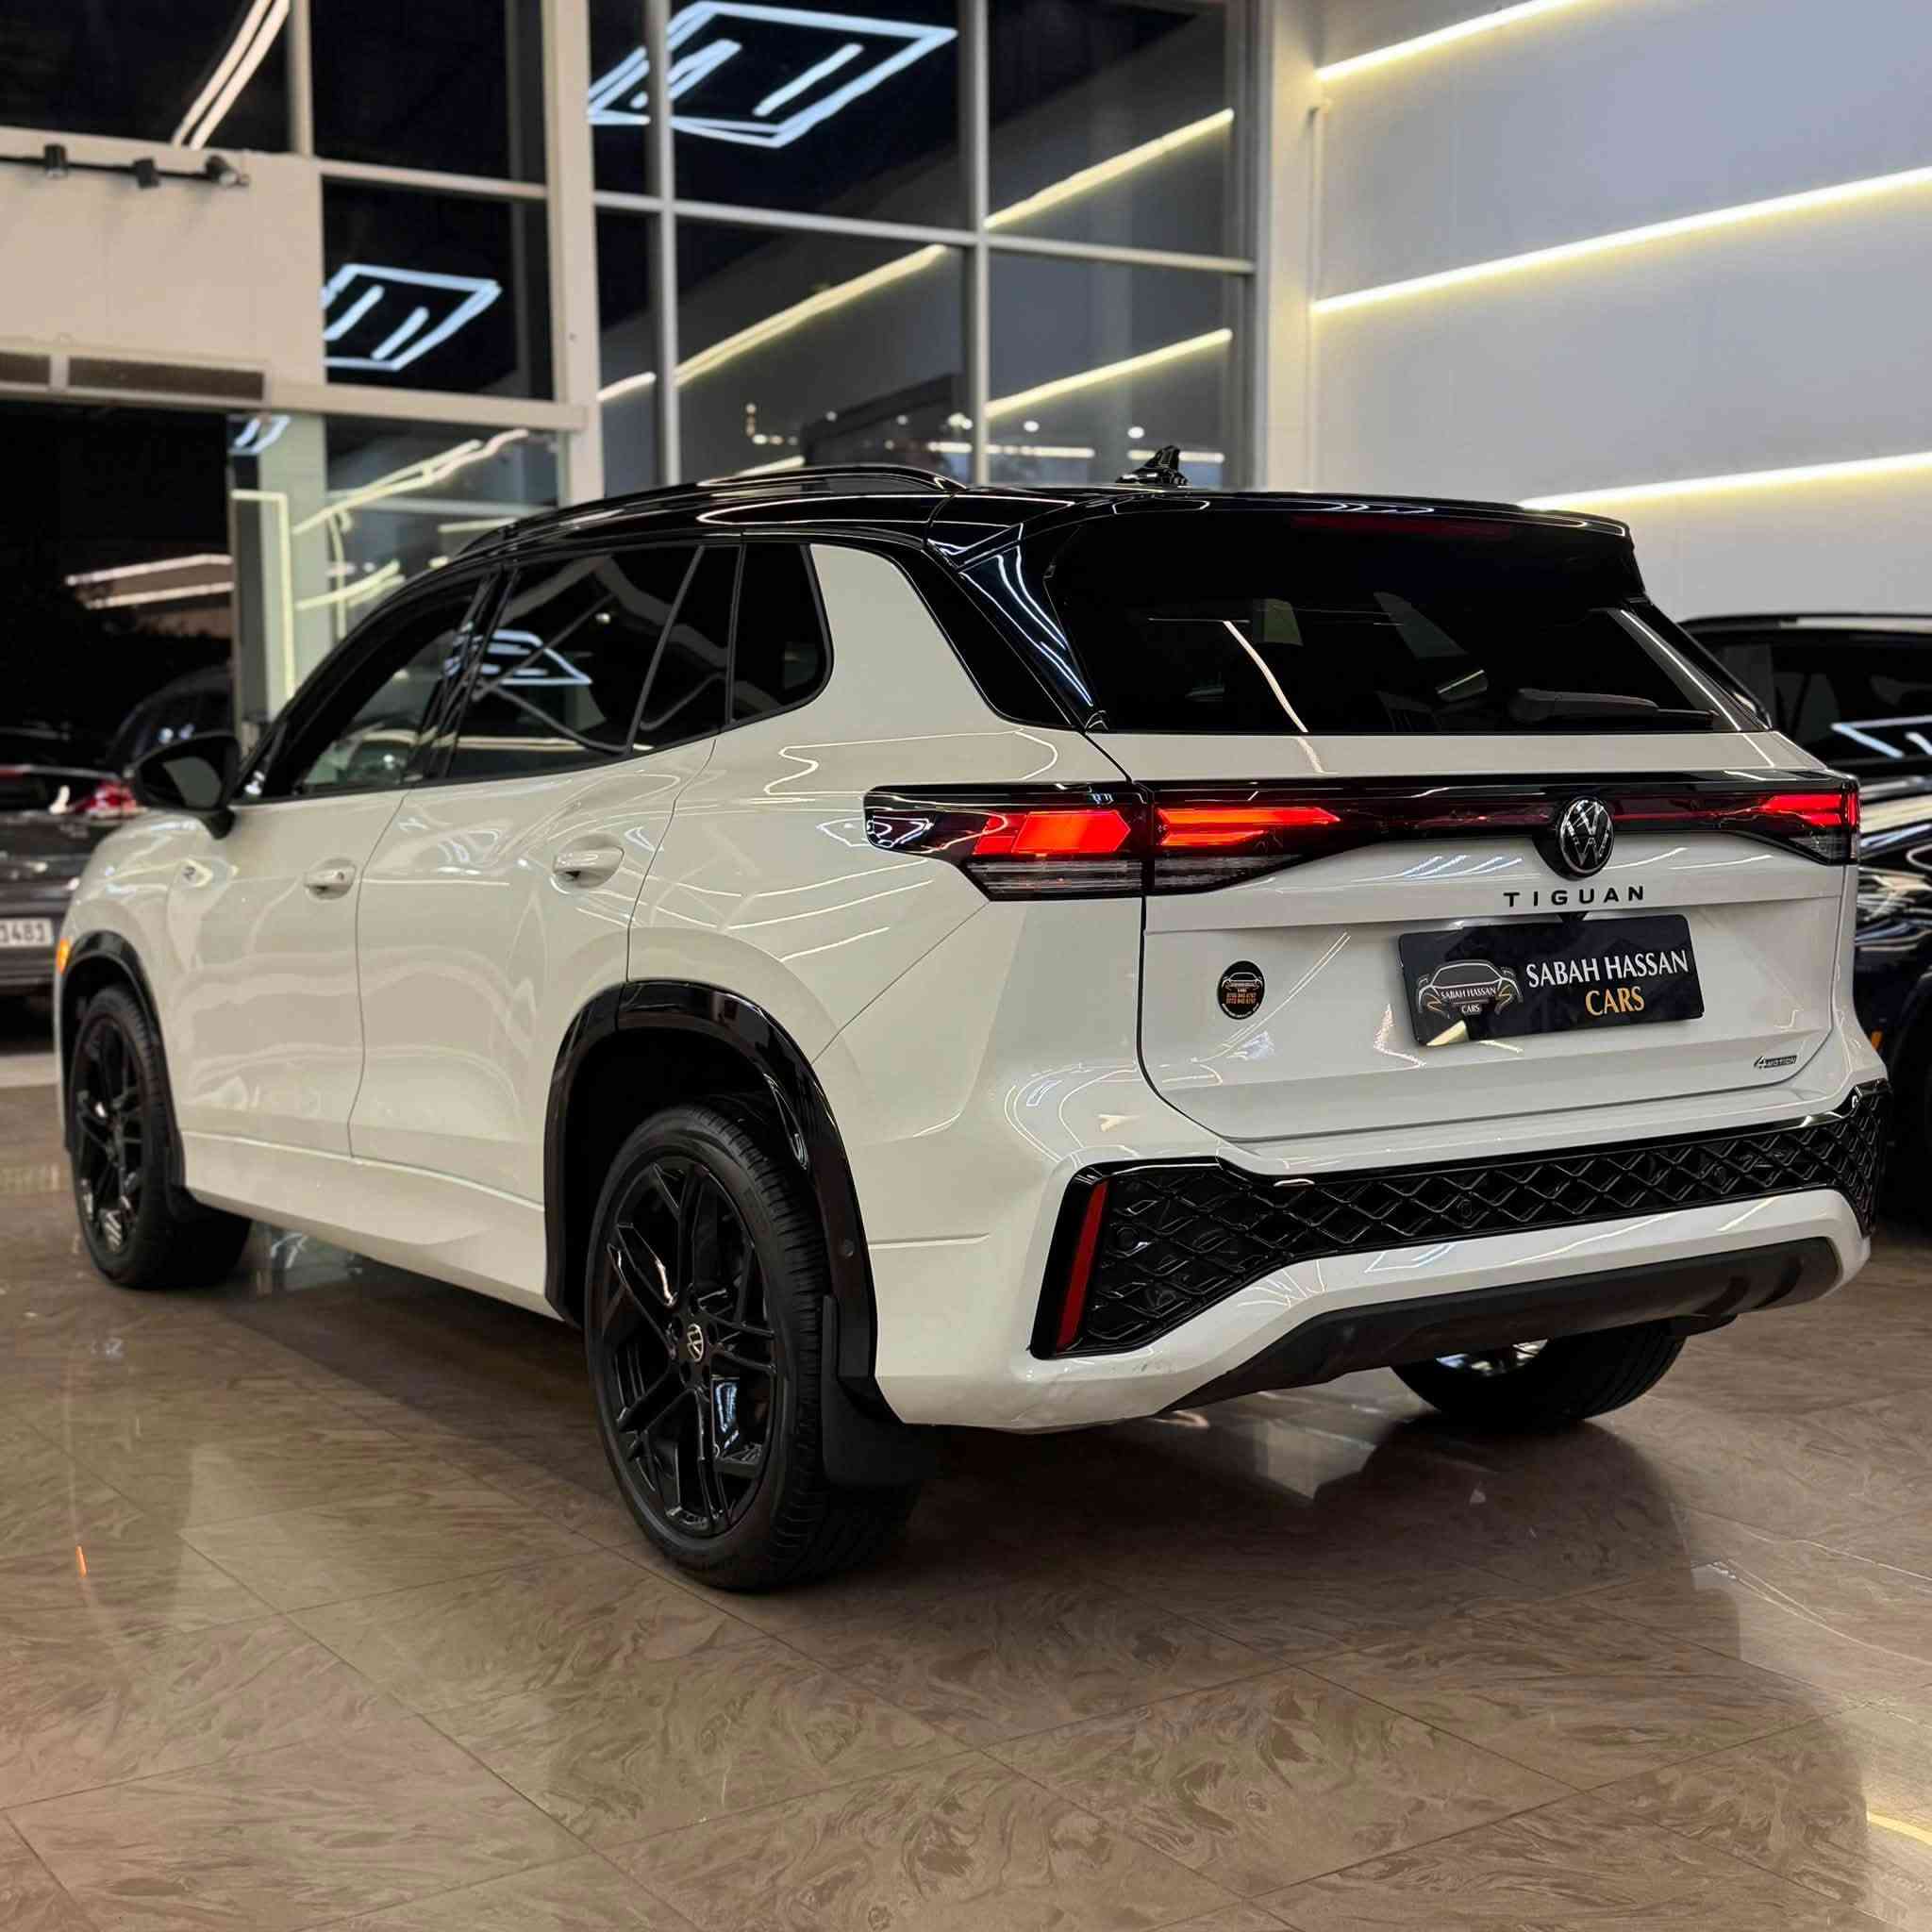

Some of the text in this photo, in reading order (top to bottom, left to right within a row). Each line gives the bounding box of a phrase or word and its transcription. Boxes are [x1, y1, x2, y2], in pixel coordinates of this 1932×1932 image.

[1503, 886, 1644, 908] TIGUAN
[1525, 950, 1690, 989] SABAH HASSAN
[1466, 986, 1497, 998] HASSAN
[1585, 986, 1646, 1017] CARS
[1460, 1003, 1480, 1014] CARS
